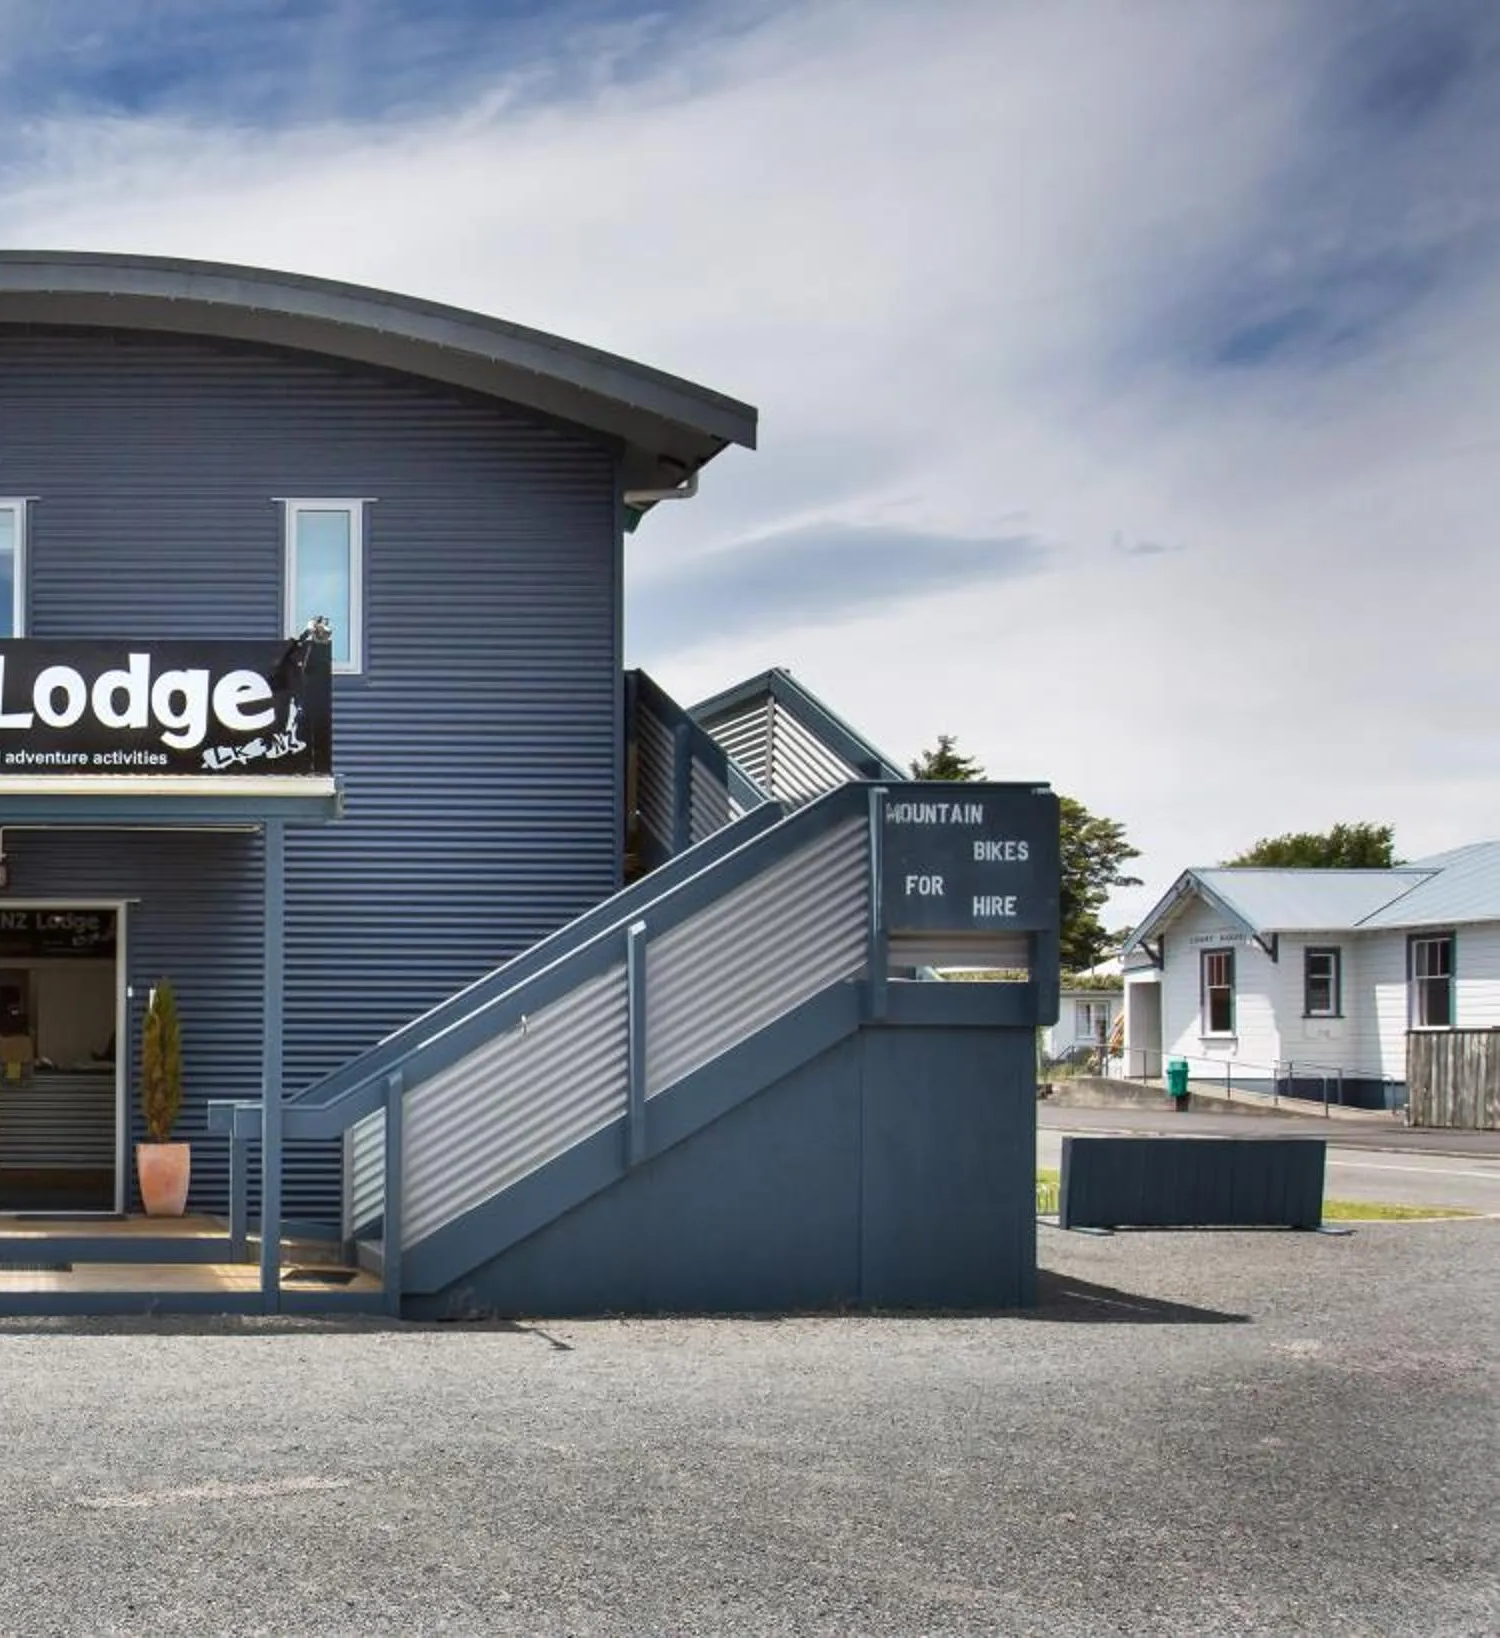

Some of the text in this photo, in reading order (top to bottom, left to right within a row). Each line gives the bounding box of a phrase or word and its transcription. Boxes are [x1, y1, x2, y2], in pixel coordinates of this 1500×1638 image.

[5, 750, 89, 765] adventure
[93, 750, 168, 765] activities
[885, 803, 984, 825] MOUNTAIN
[973, 841, 1029, 861] BIKES
[905, 875, 944, 896] FOR
[972, 896, 1017, 916] HIRE
[1, 911, 28, 930] NZ
